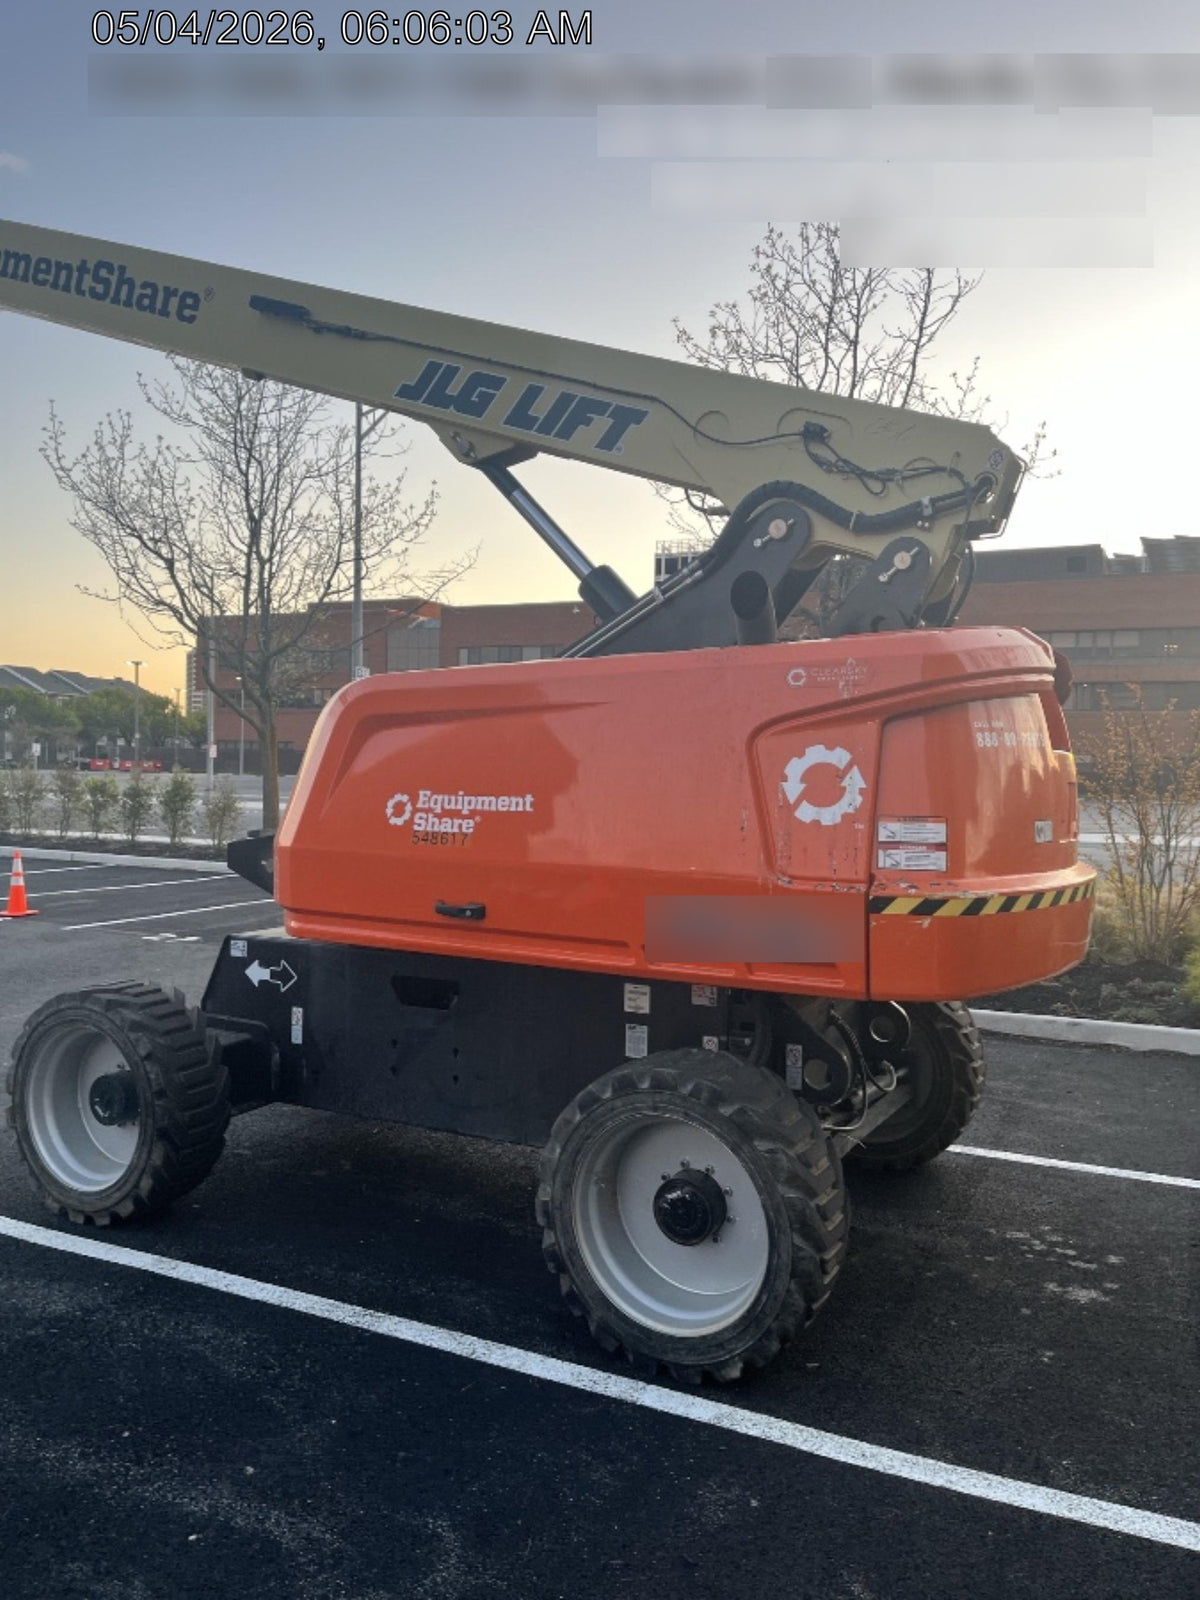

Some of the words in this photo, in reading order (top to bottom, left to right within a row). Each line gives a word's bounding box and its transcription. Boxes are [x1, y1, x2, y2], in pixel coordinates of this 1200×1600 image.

[0, 248, 201, 324] mentShare
[393, 359, 509, 420] JLG
[502, 382, 650, 453] LIFT
[416, 790, 535, 815] Equipment
[411, 830, 469, 847] 548617
